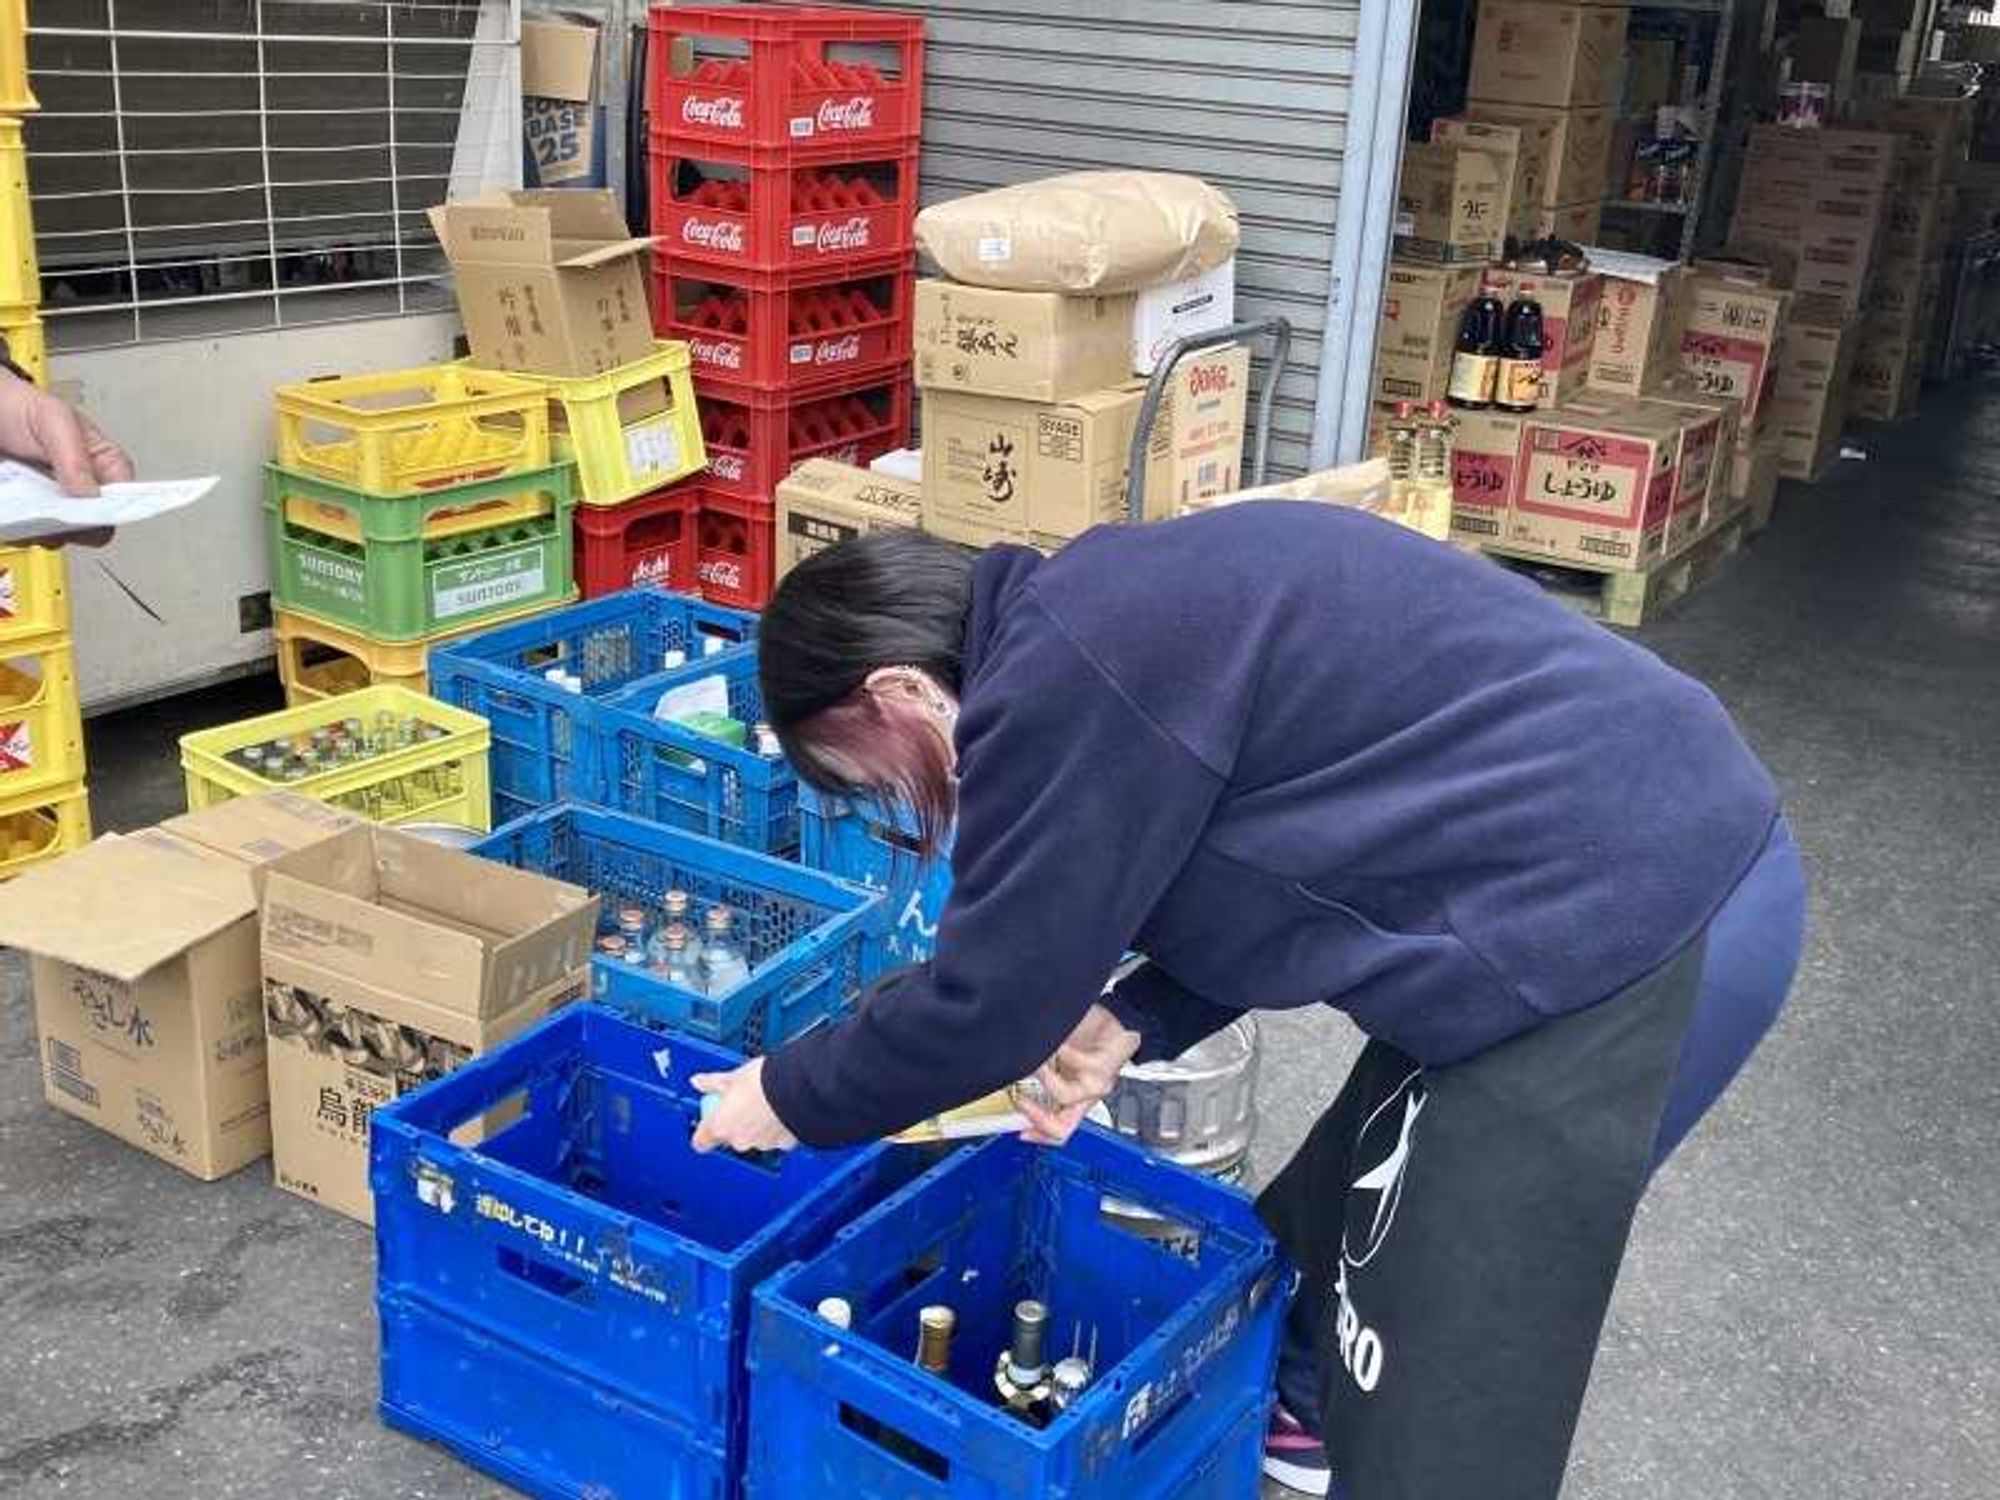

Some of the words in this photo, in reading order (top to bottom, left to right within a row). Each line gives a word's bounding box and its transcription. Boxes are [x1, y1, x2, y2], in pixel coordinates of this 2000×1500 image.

[528, 104, 589, 139] BASE
[682, 96, 744, 128] Coca-Cola
[817, 97, 874, 131] Coca-Cola
[538, 132, 581, 166] 25
[682, 217, 743, 251] Coca-Cola
[817, 217, 870, 253] Coca-Cola
[815, 334, 861, 366] Coca-Cola
[980, 432, 1017, 503] 山崎
[1543, 472, 1616, 502] しょうゆ
[456, 581, 522, 605] SUNTORY
